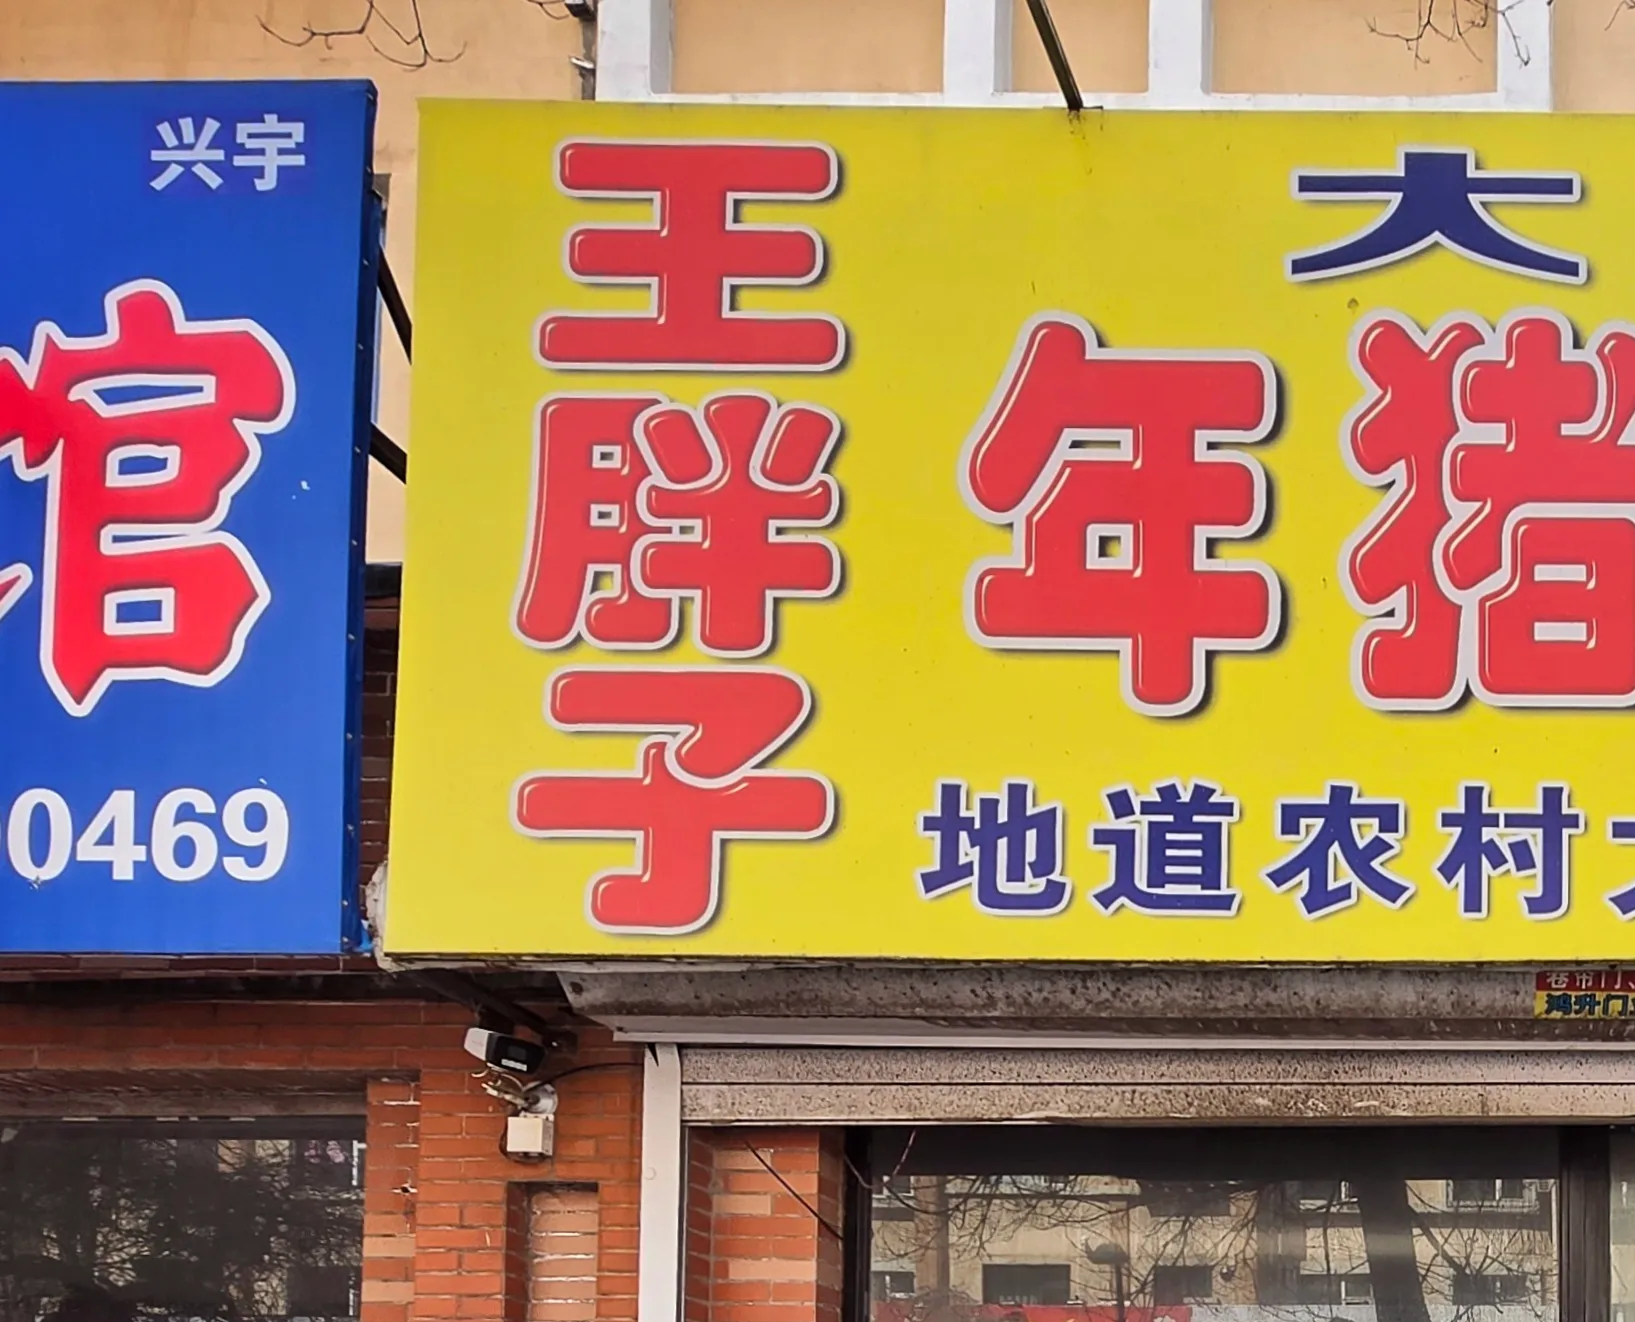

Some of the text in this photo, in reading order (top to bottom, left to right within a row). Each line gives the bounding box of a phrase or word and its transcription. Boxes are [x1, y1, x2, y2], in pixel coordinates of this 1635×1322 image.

[151, 115, 307, 191] 兴宇
[511, 141, 847, 936] 王胖子
[7, 788, 290, 882] 0469
